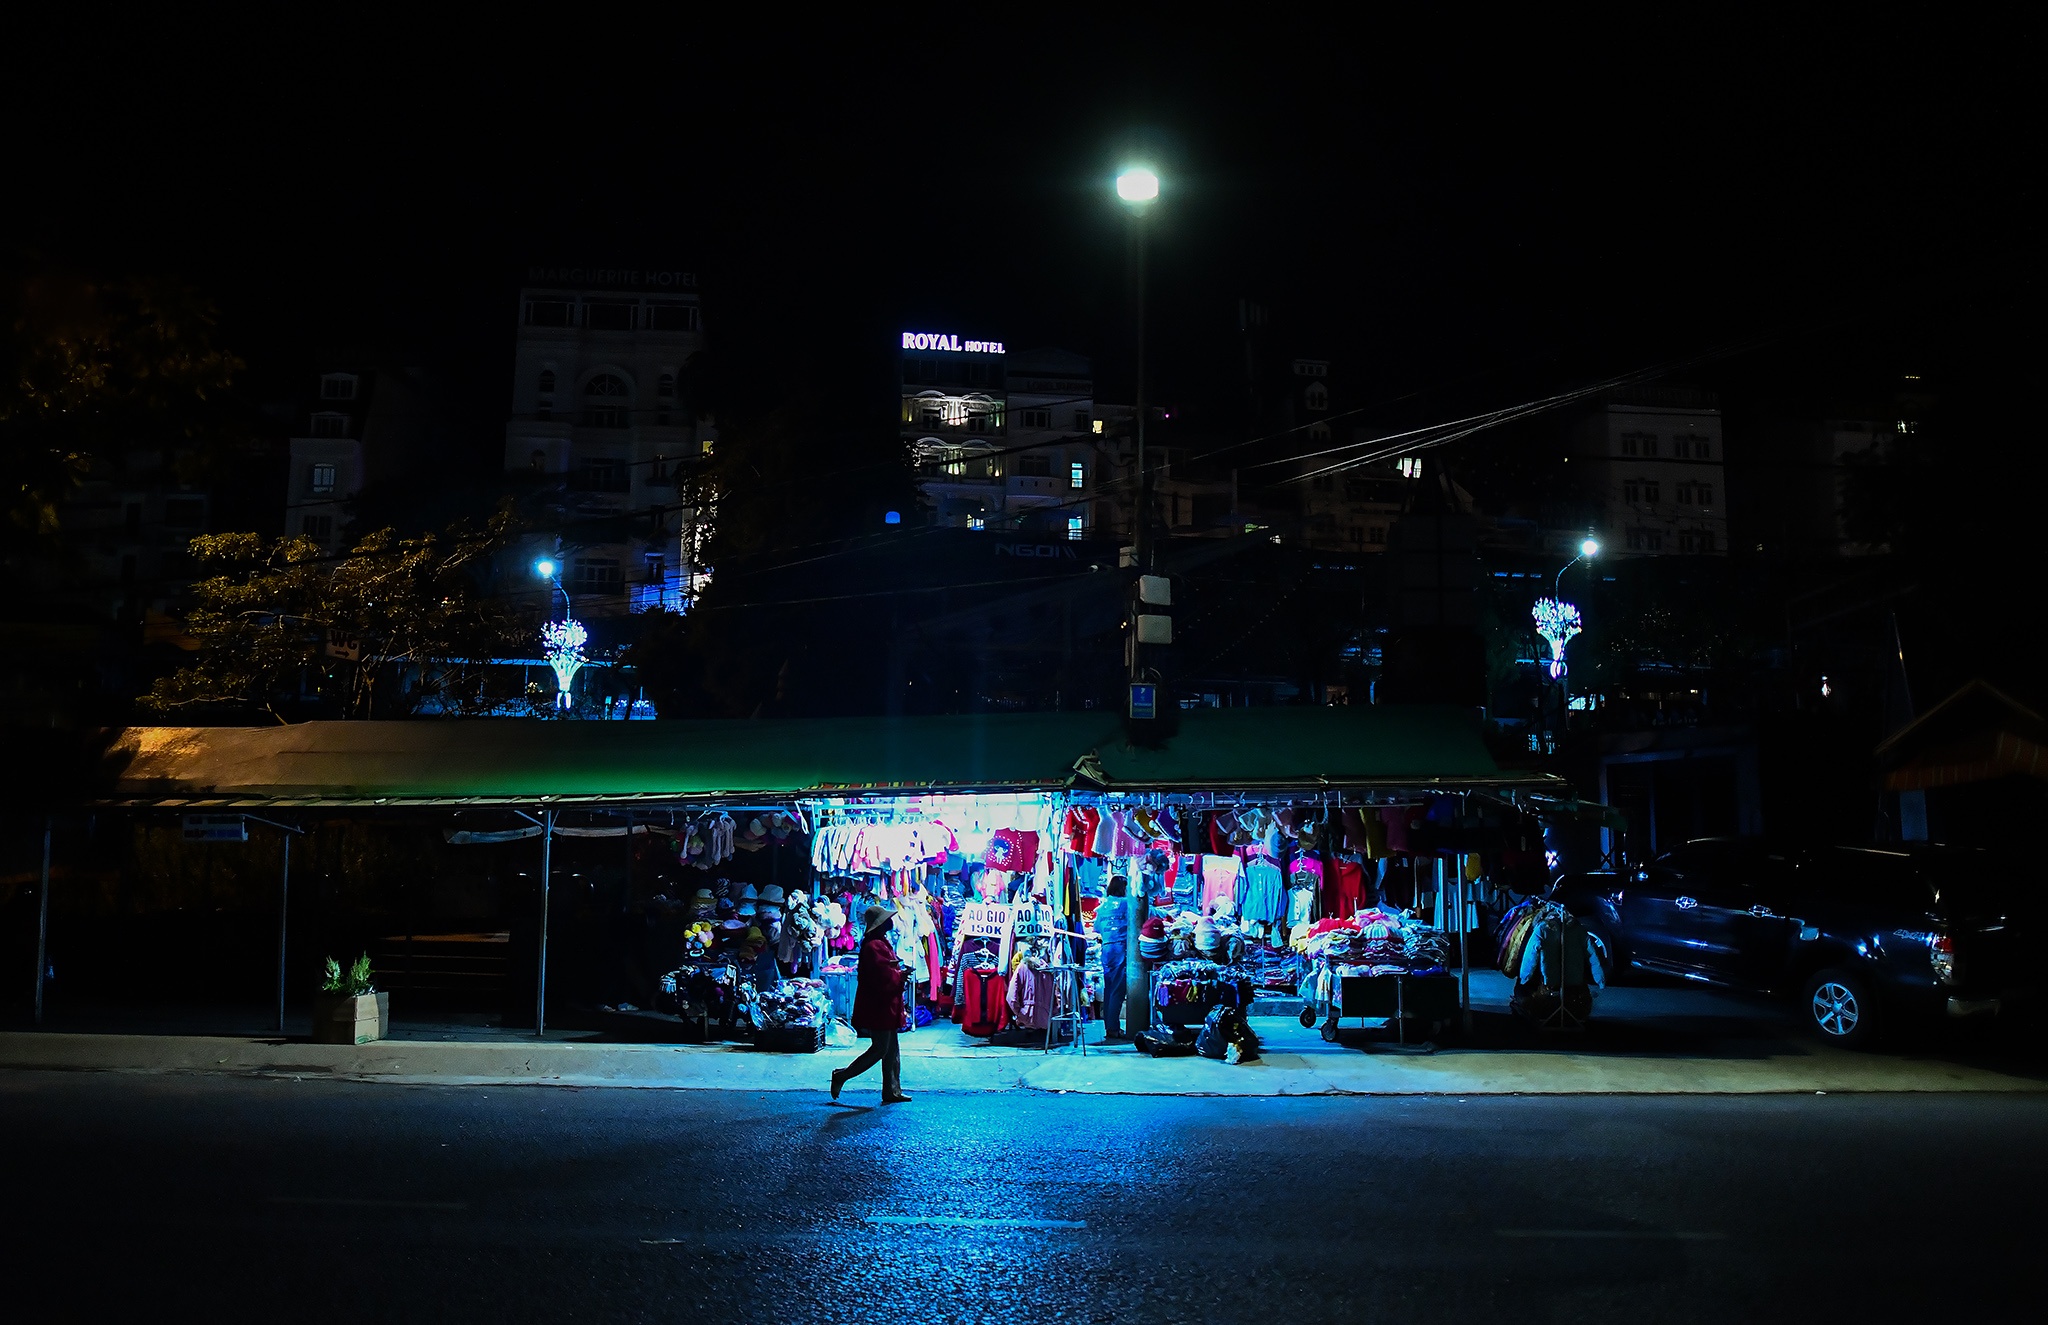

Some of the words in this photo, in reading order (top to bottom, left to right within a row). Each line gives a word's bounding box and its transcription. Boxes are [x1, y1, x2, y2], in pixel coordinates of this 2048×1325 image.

[528, 266, 640, 285] MARGUERITE
[645, 271, 698, 287] HOTEL
[902, 332, 962, 352] ROYAL
[964, 340, 1006, 354] HOTEL
